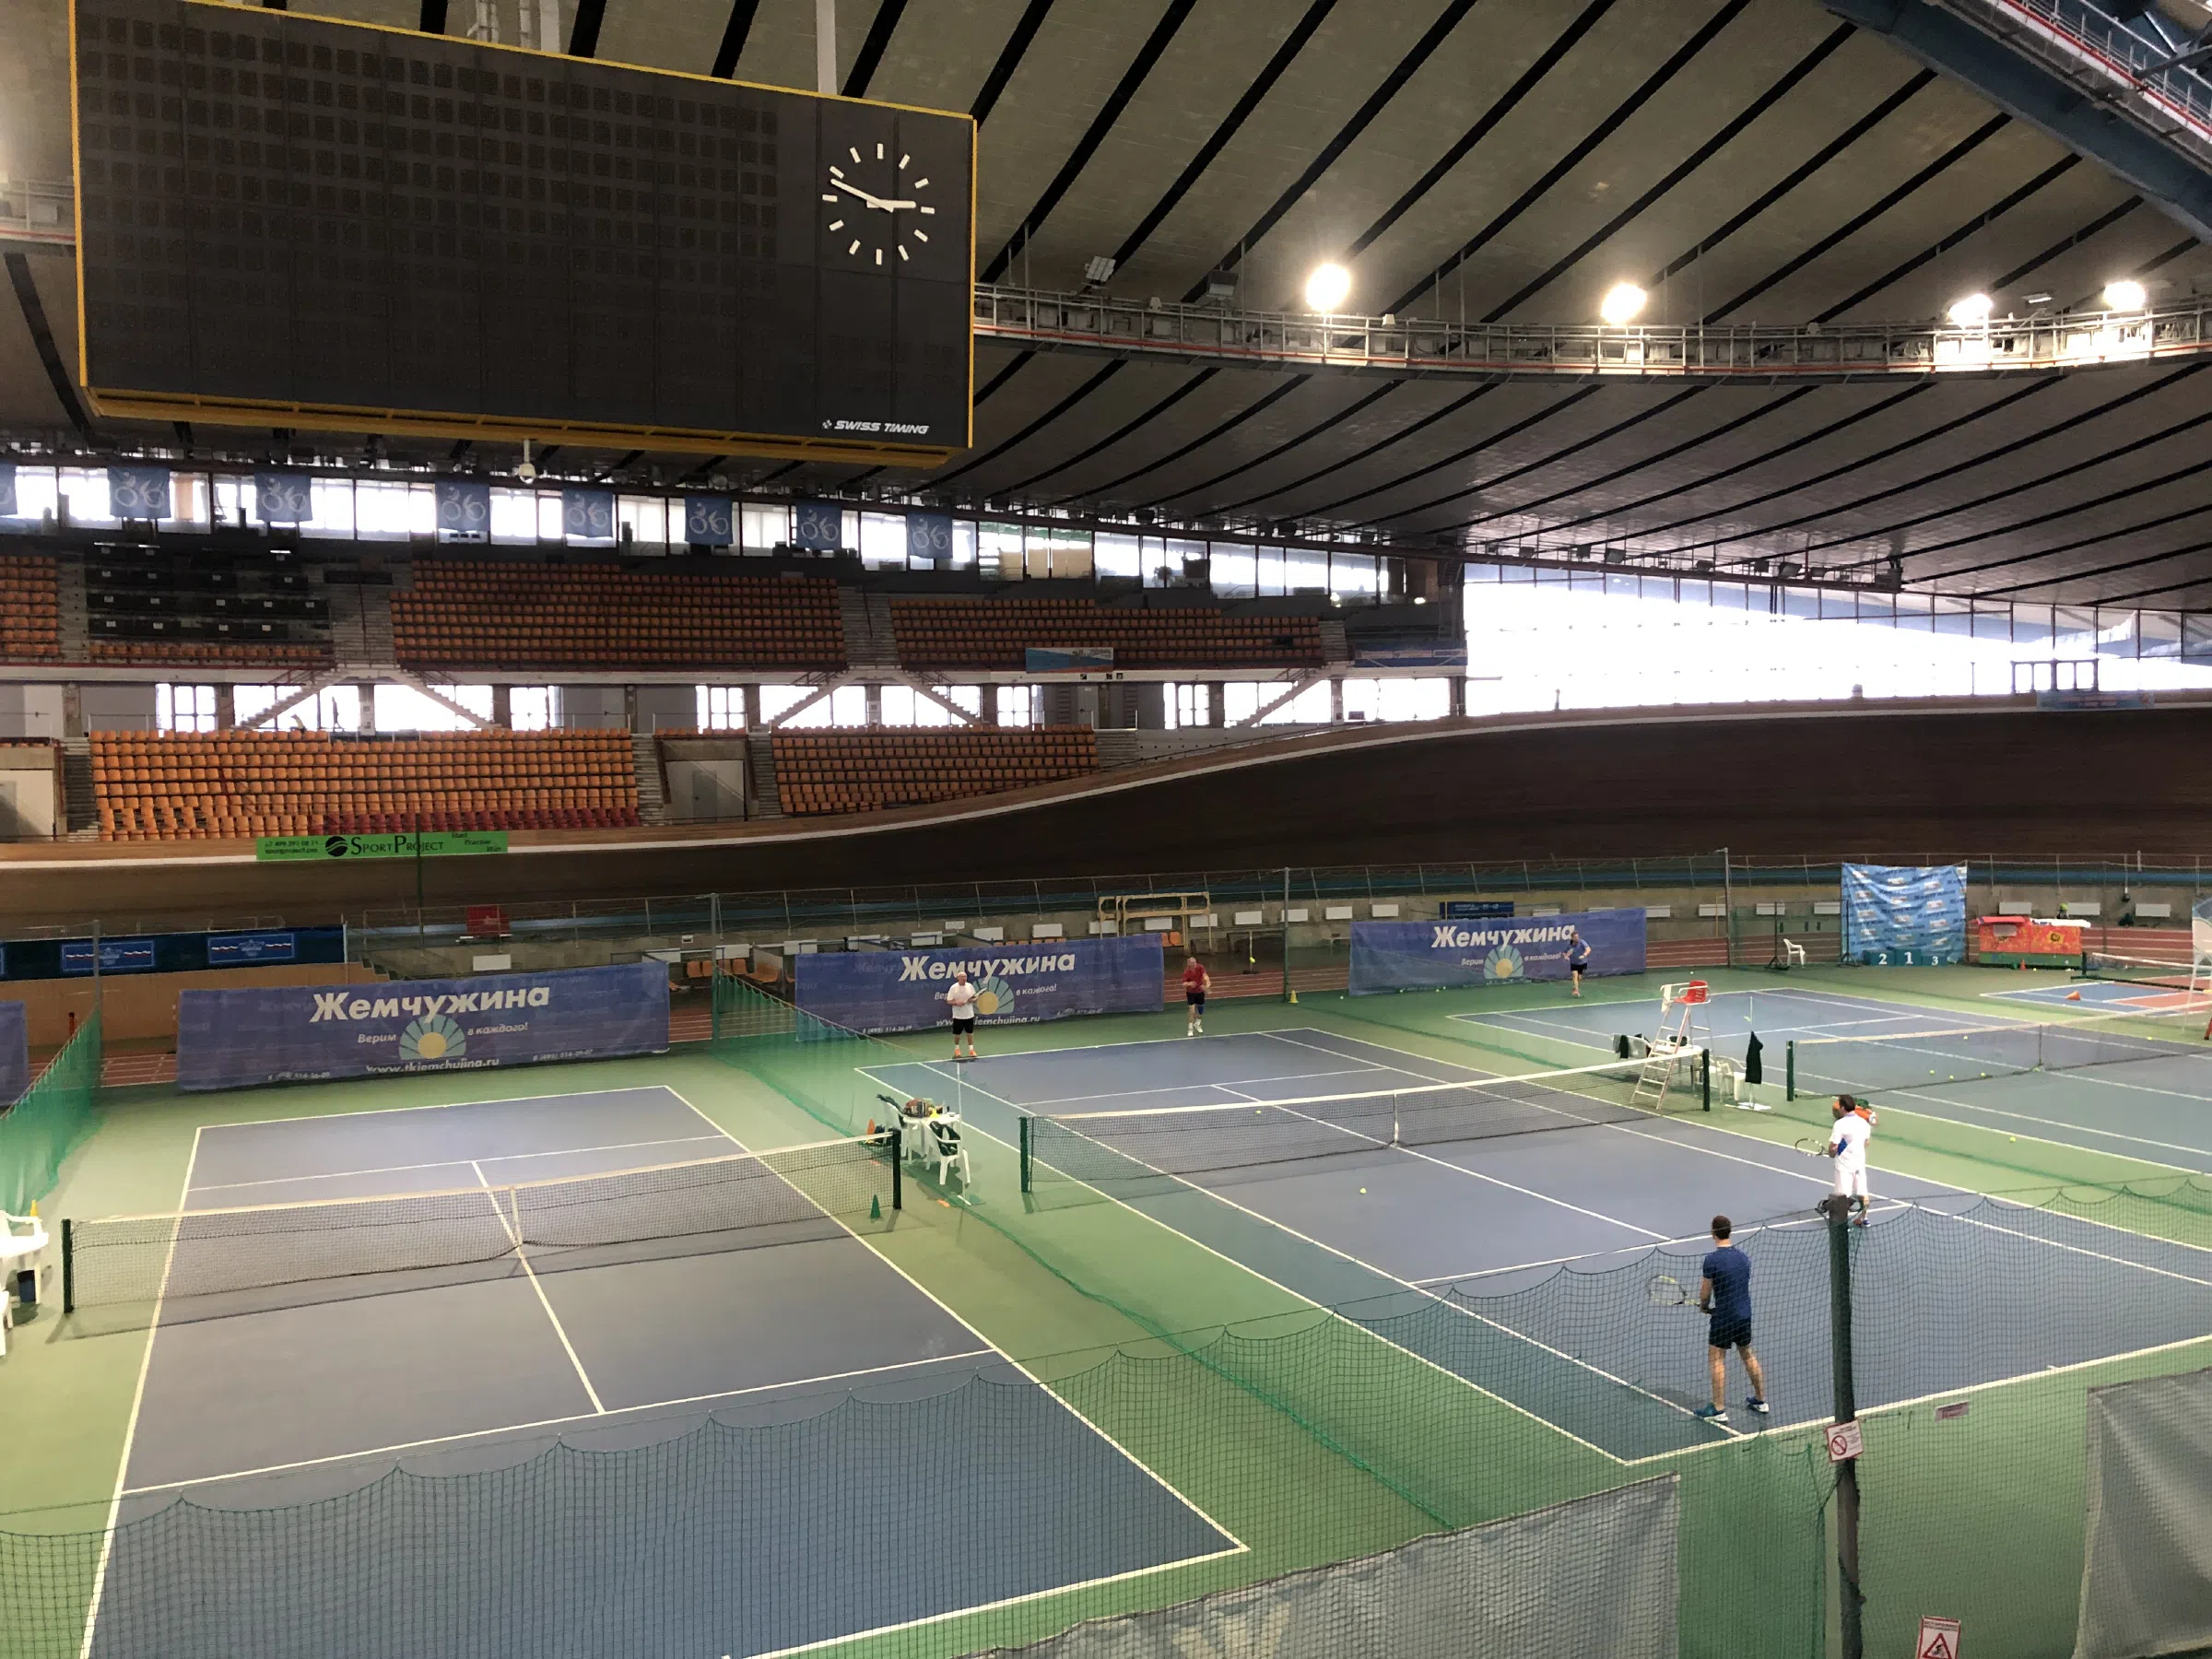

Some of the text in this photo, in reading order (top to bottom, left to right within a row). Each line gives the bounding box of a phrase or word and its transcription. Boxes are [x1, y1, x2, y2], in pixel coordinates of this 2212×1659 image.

[834, 420, 929, 434] SWISS TIMING
[1431, 924, 1575, 951] Жемчужина
[898, 953, 1076, 983] Жемчужина
[1461, 958, 1484, 966] Верим
[1878, 951, 1939, 966] 2 1 3
[309, 986, 550, 1024] Жемчужина
[357, 1033, 397, 1043] Верим
[476, 1021, 528, 1035] каждого!
